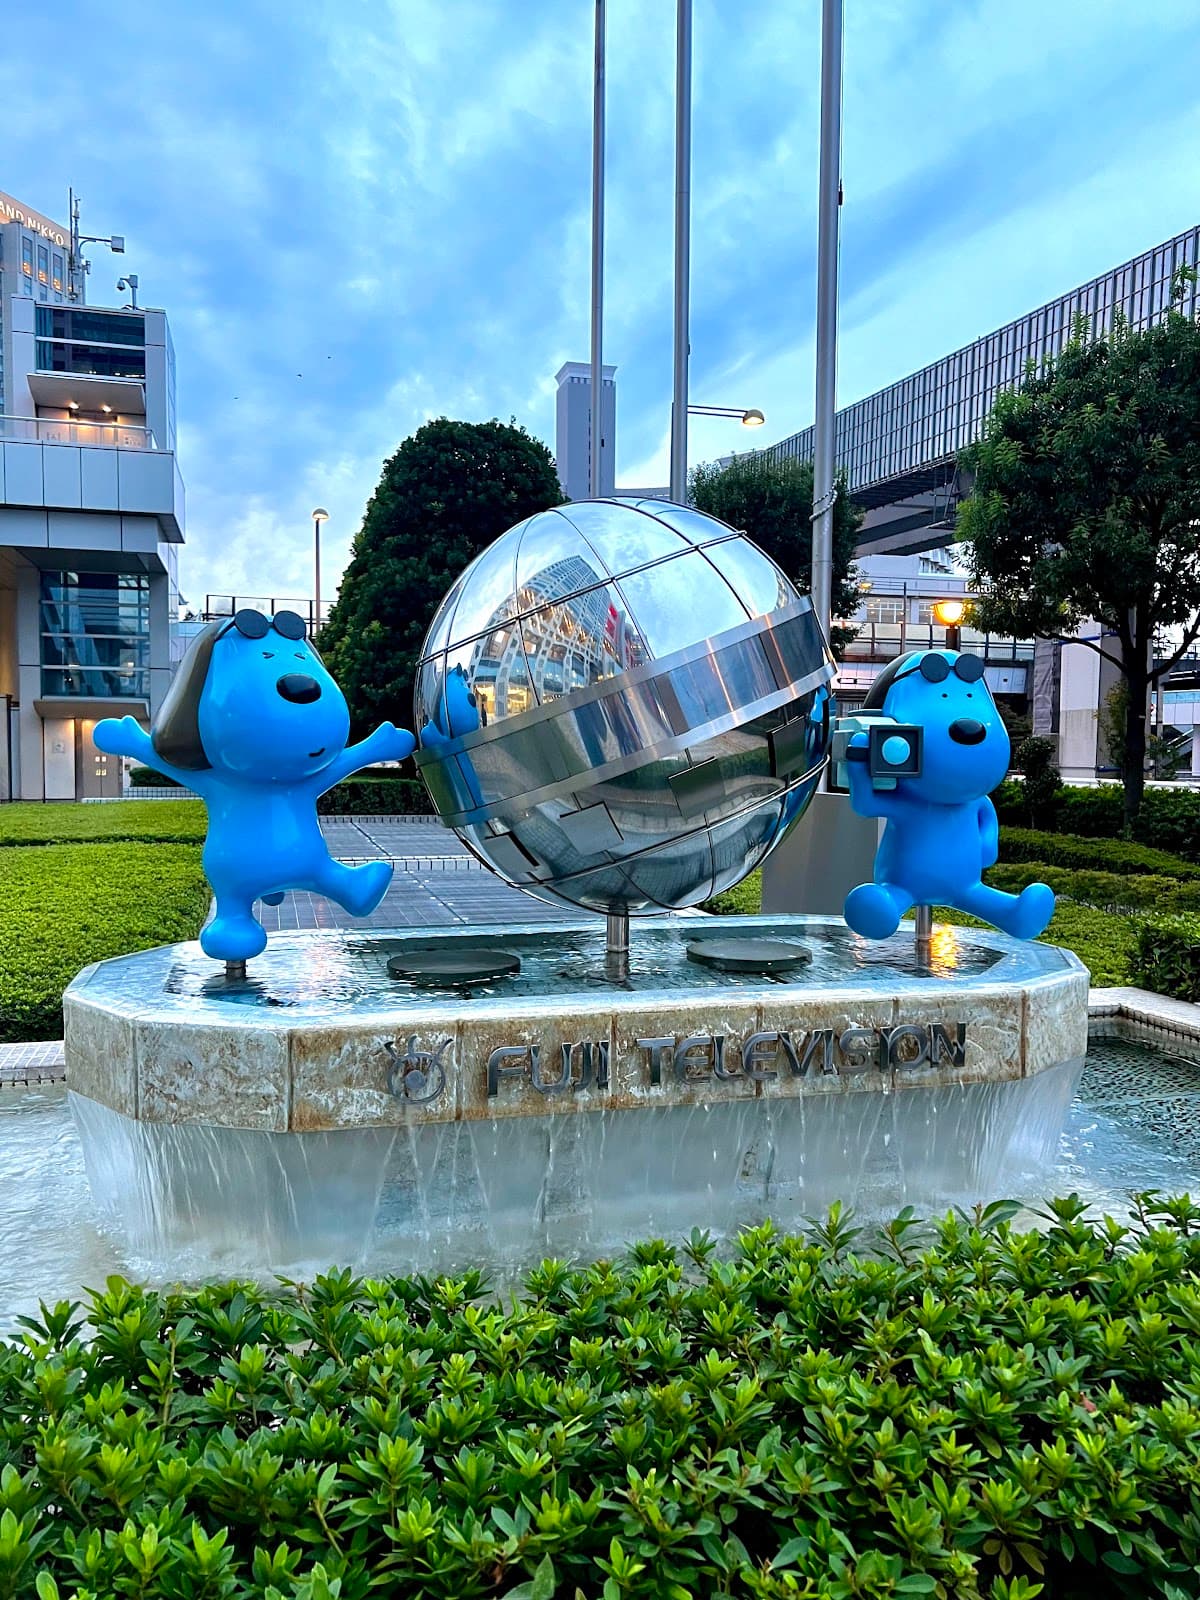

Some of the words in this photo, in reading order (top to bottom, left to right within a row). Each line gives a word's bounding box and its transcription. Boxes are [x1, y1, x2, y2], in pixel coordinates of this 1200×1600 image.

[27, 216, 65, 246] NIKKO
[487, 1040, 609, 1098] FUJI
[636, 1021, 967, 1087] TELEVISION
